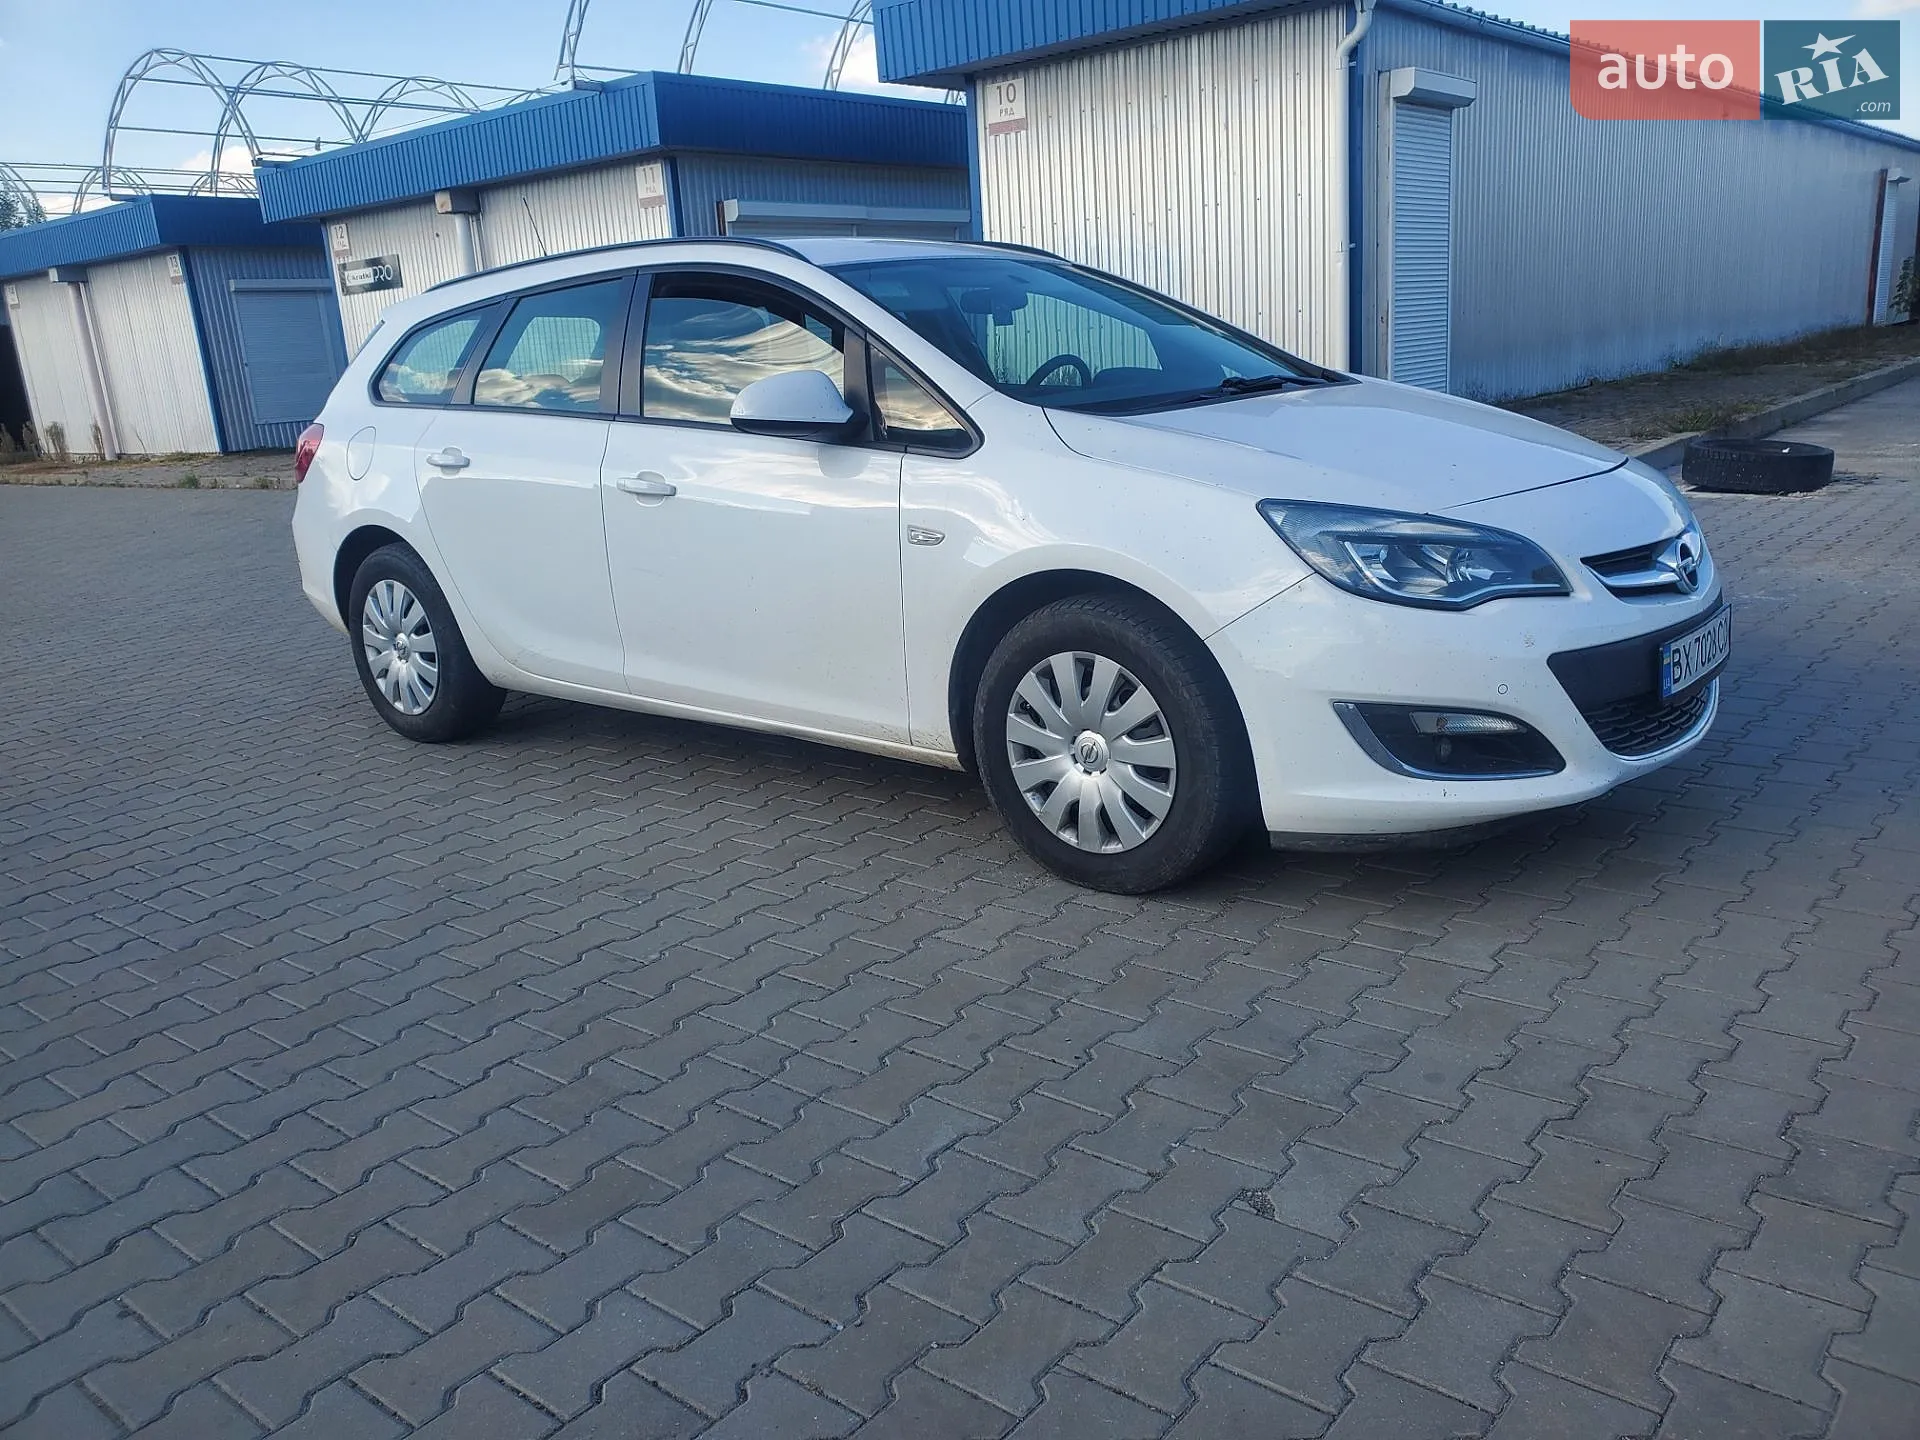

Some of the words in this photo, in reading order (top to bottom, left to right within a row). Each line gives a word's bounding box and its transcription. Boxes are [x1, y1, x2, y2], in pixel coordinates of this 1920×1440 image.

[996, 83, 1016, 105] 10
[334, 226, 345, 239] 12
[372, 264, 393, 282] PRO
[1672, 640, 1692, 684] BX
